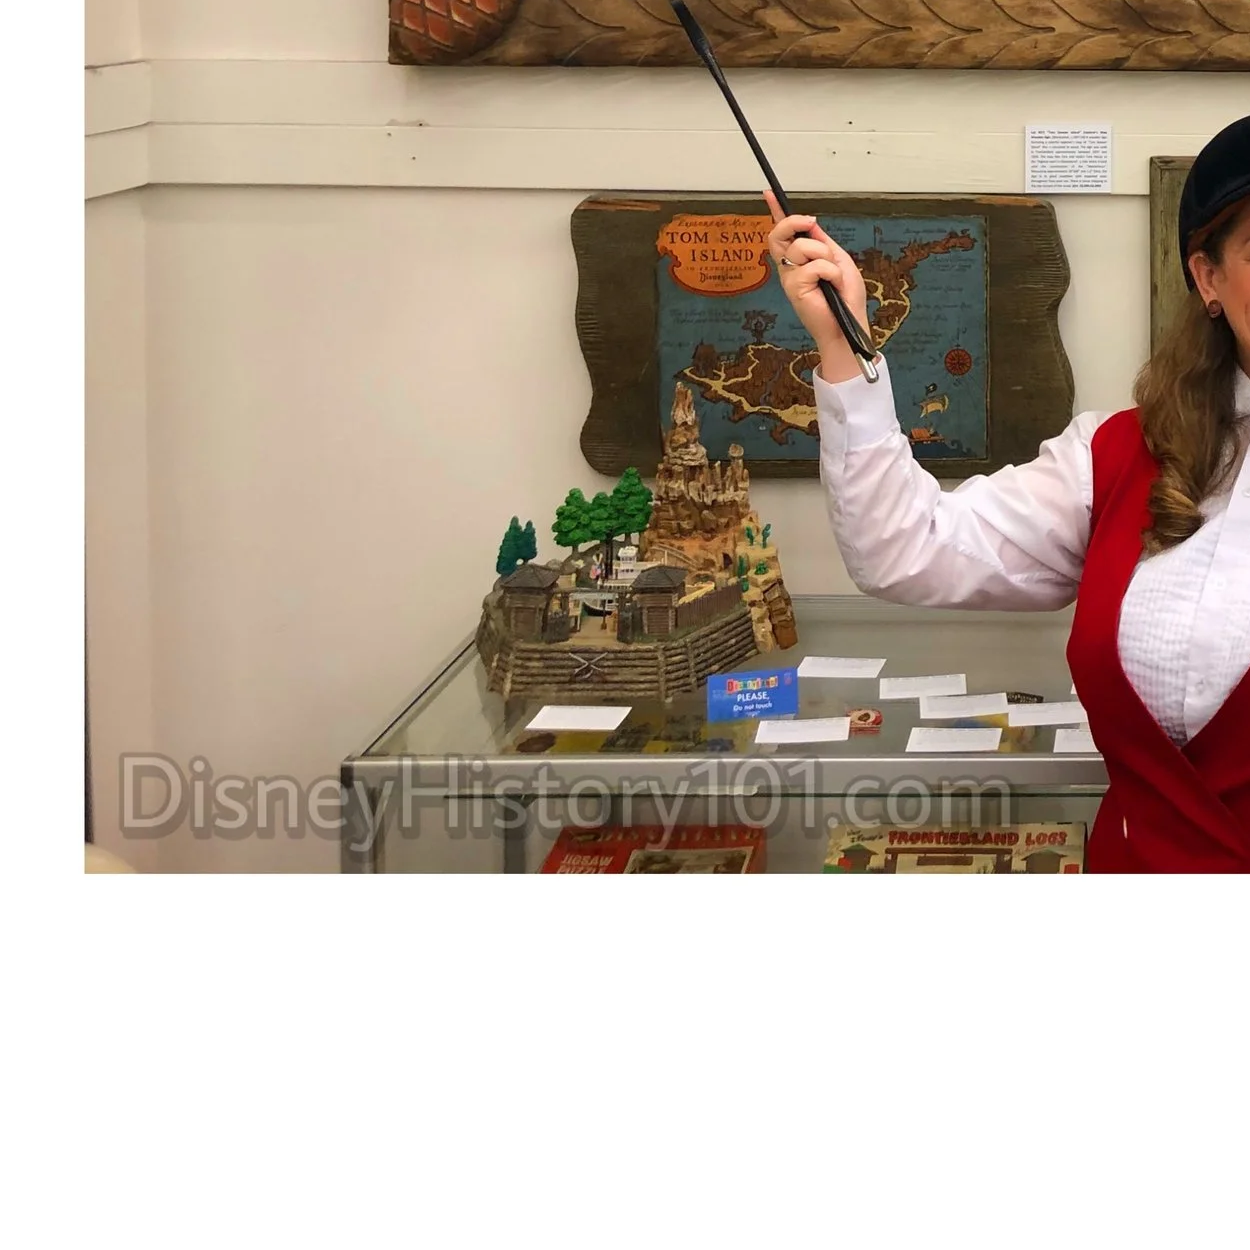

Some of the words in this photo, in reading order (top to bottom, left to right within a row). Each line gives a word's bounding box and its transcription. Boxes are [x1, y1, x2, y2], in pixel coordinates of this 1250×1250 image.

[666, 231, 709, 244] TOM
[719, 231, 770, 244] SAWY
[691, 249, 754, 262] ISLAND
[733, 704, 743, 712] Do
[744, 703, 755, 711] not
[755, 701, 773, 710] touch
[888, 829, 1020, 847] FRONTIERLAND
[1025, 830, 1068, 847] LOGS
[562, 854, 614, 866] JIGSAW
